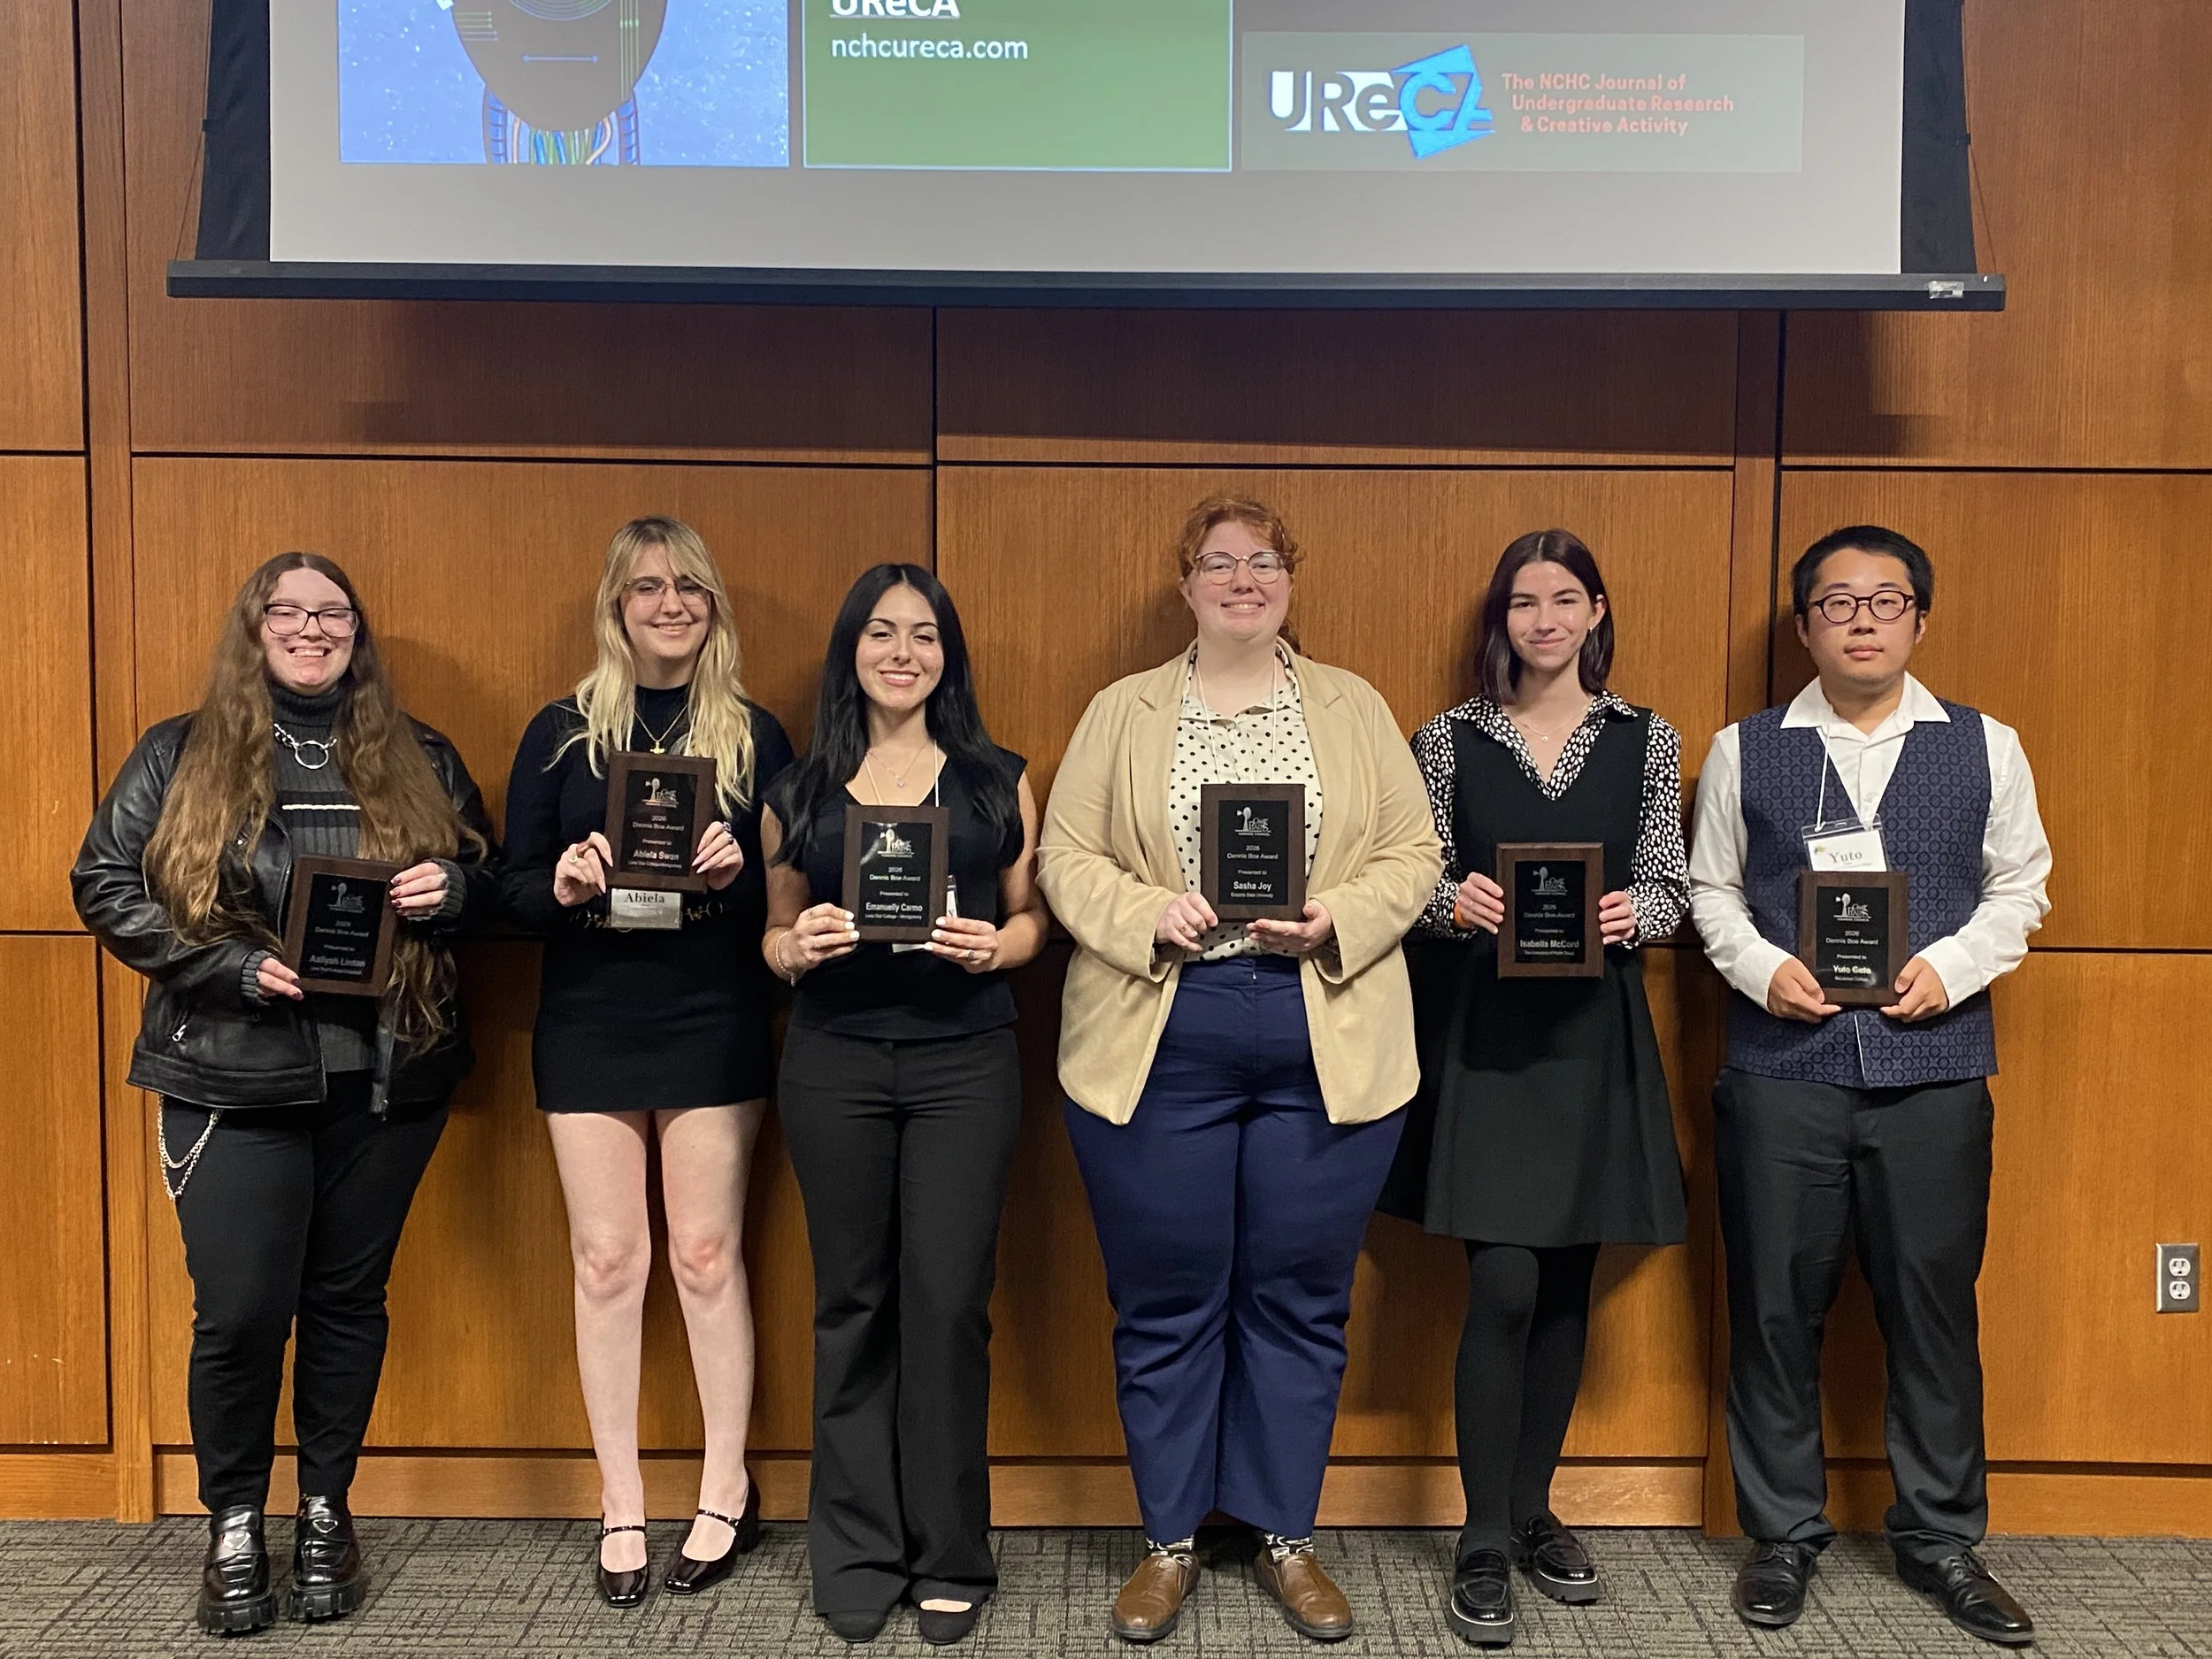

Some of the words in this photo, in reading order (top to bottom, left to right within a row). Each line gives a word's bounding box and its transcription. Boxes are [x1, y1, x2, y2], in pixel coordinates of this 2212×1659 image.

[832, 0, 960, 17] UReCA
[832, 33, 1028, 59] nchcureca.com
[1502, 73, 1535, 90] The
[1539, 73, 1590, 90] NCHC
[1594, 73, 1663, 91] Journal
[1667, 73, 1686, 91] of
[1511, 95, 1647, 115] Undergraduate
[1650, 96, 1734, 112] Research
[1520, 117, 1533, 133] &
[1536, 117, 1612, 134] Creative
[1617, 118, 1688, 137] Activity
[634, 849, 657, 859] Abiela
[658, 851, 680, 860] Swan
[1828, 851, 1863, 864] Yuto
[1233, 881, 1256, 890] Sasha
[1257, 881, 1272, 892] Joy
[625, 892, 665, 903] Abiela
[865, 902, 900, 913] Emanuelly
[901, 902, 923, 911] Carmo
[1520, 940, 1548, 949] Isabella
[1550, 940, 1580, 949] McCord
[1832, 964, 1851, 973] Yuto
